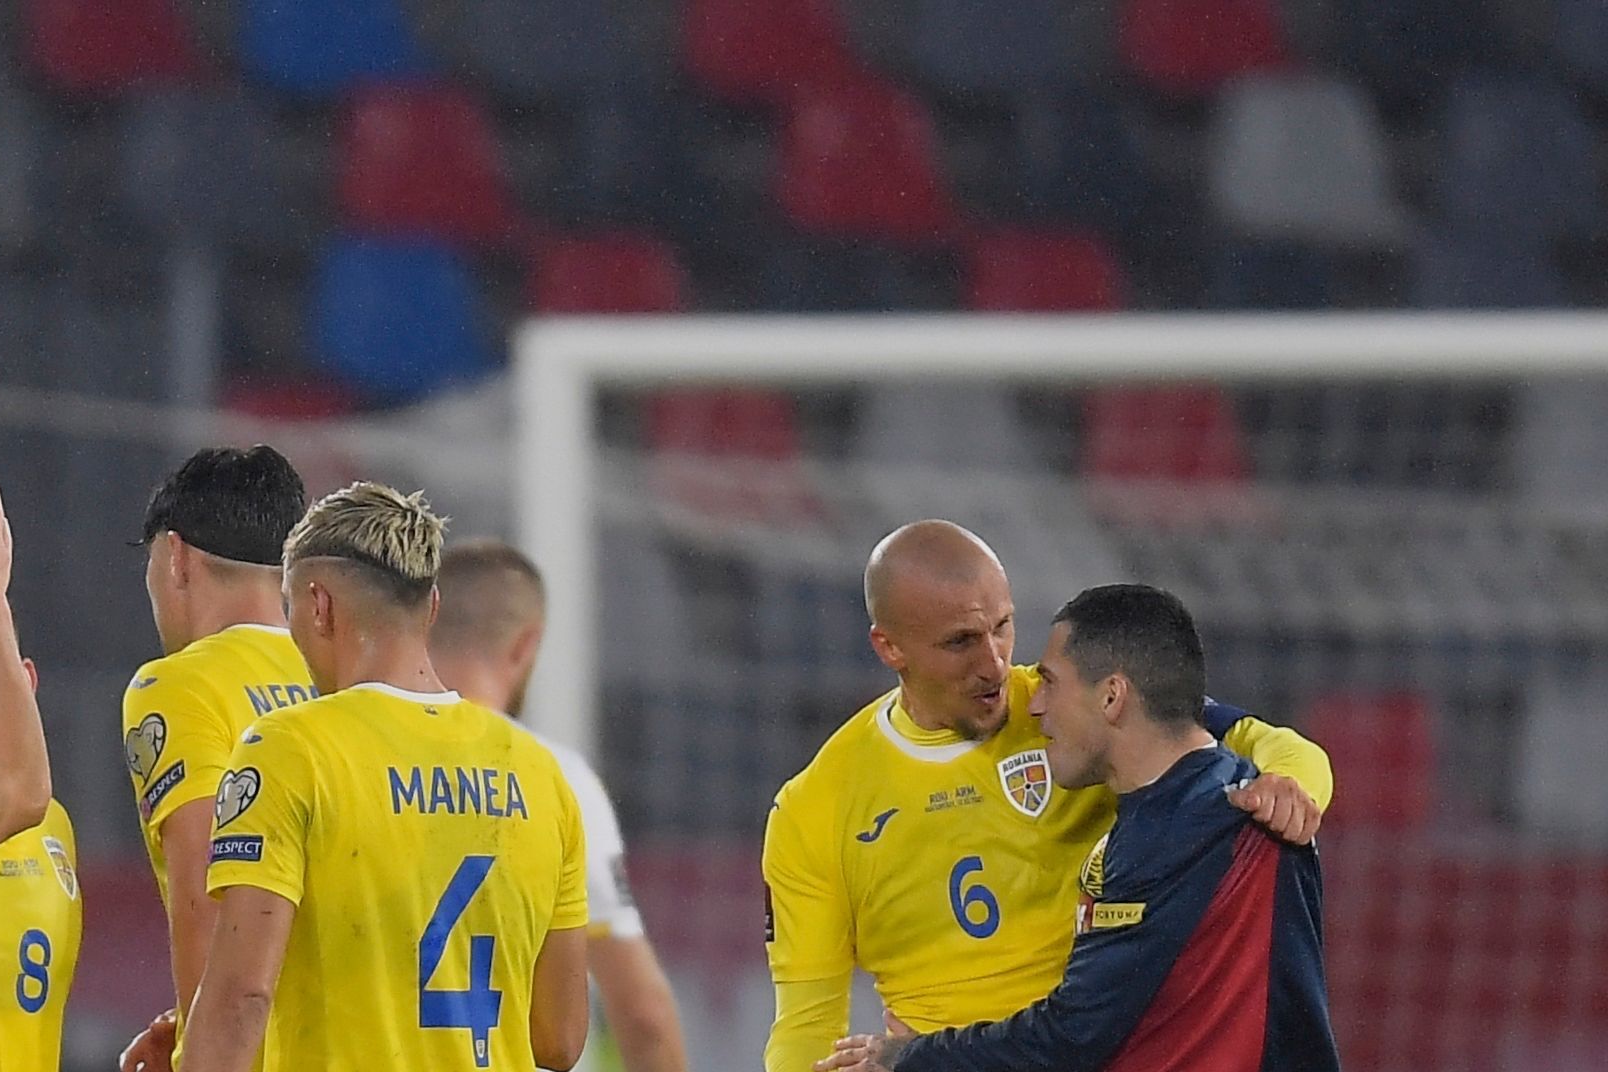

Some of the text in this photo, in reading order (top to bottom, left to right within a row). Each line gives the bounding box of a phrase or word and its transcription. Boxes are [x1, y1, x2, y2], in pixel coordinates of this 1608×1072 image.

[244, 684, 320, 717] NED
[388, 767, 528, 820] MANEA
[949, 855, 1001, 940] 6
[16, 928, 52, 1014] 8
[418, 855, 503, 1069] 4
